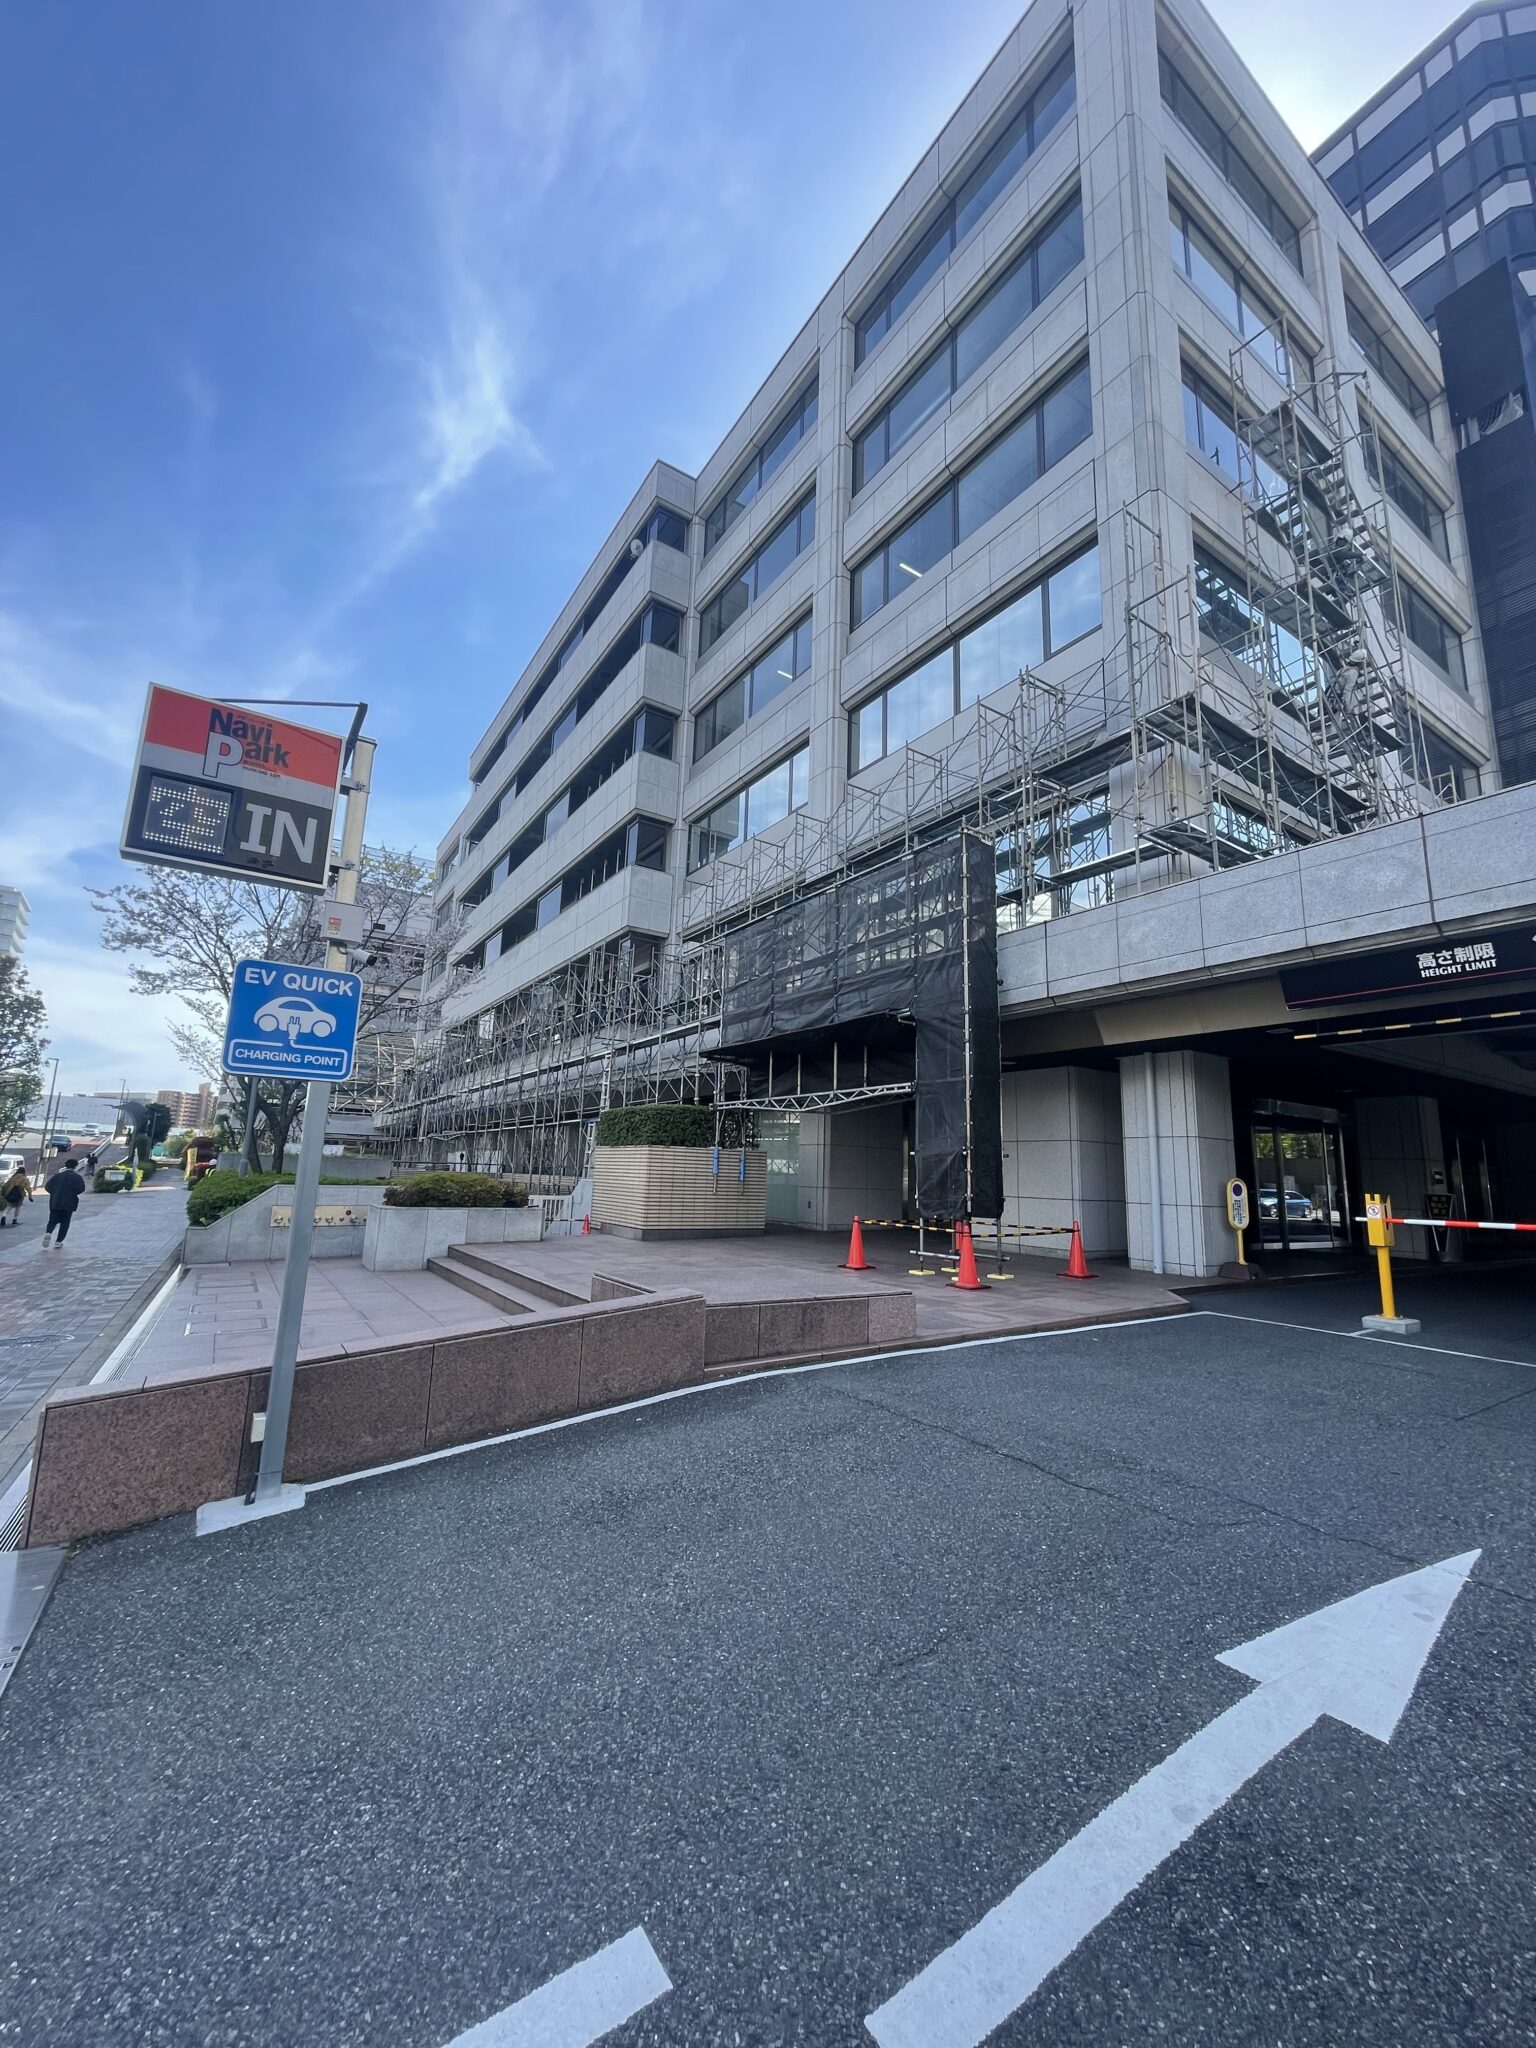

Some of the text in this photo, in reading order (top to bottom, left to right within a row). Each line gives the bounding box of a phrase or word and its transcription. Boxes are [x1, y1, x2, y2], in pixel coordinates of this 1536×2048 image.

[209, 708, 273, 746] Navi
[202, 731, 291, 779] Park
[239, 802, 318, 864] IN
[1416, 942, 1495, 969] 高さ制限
[1420, 959, 1497, 978] HEIGHT LIMIT
[244, 967, 354, 997] EV QUICK
[235, 1048, 342, 1067] CHARGING POINT
